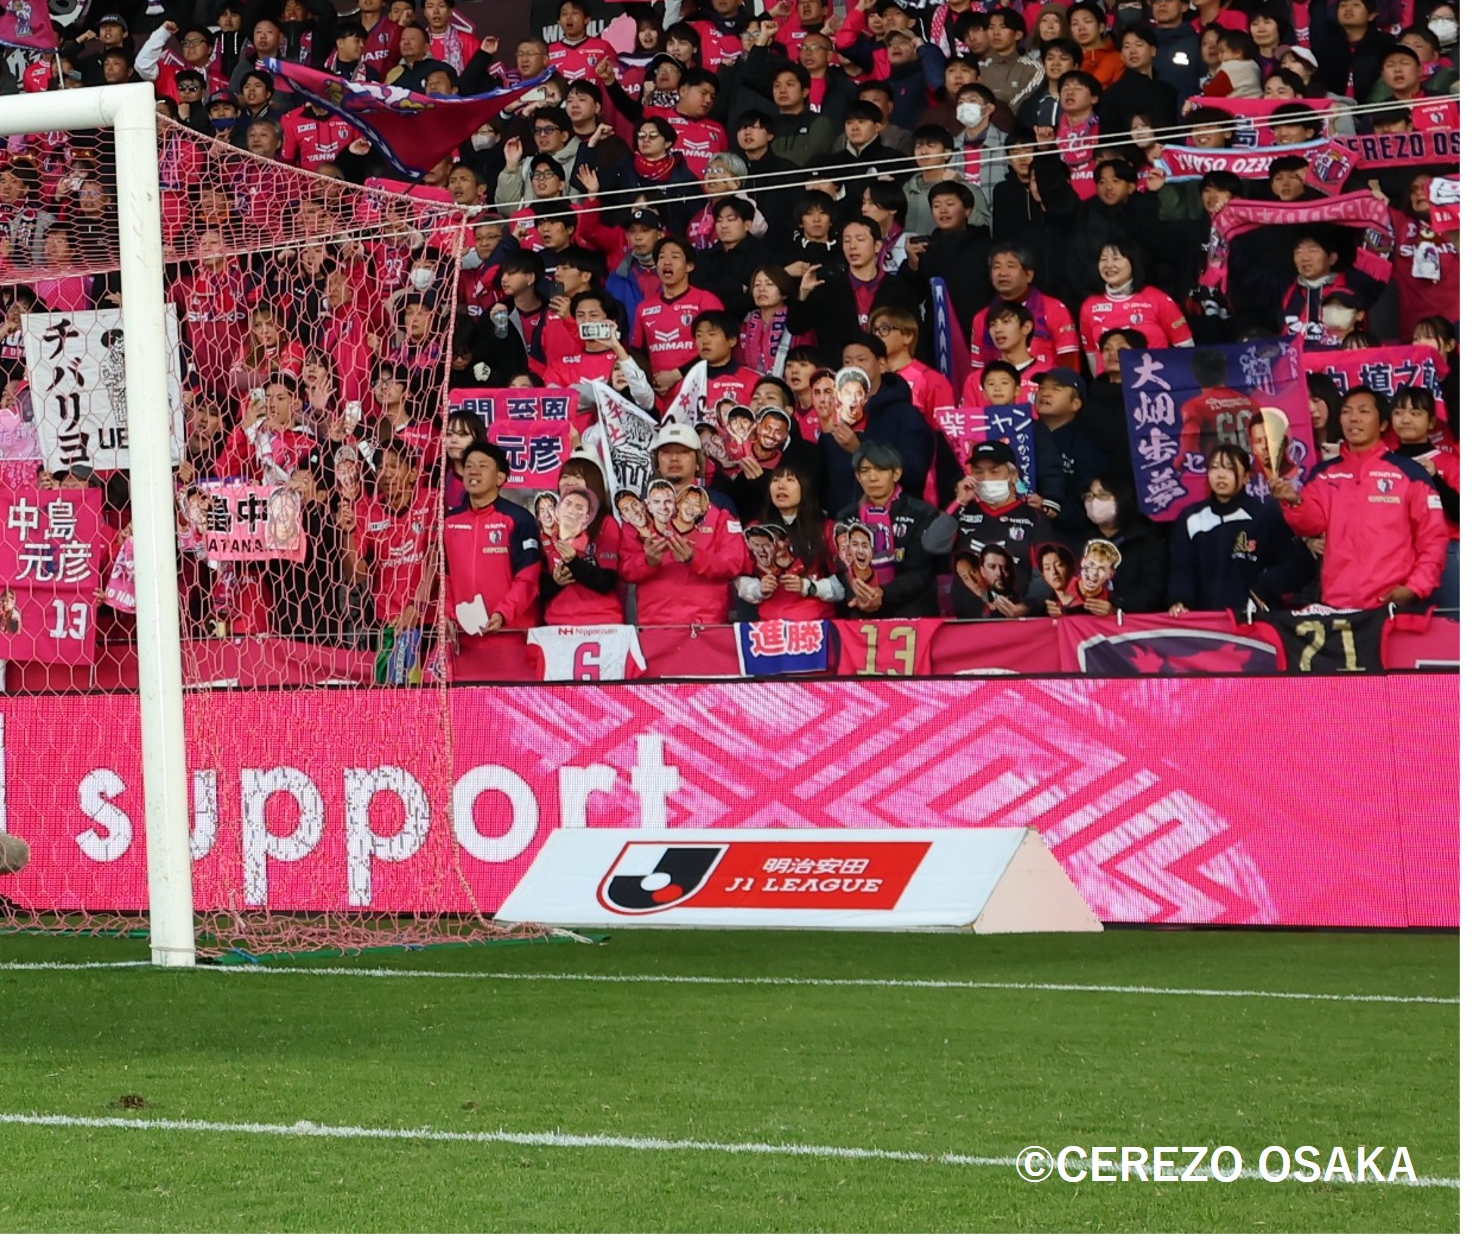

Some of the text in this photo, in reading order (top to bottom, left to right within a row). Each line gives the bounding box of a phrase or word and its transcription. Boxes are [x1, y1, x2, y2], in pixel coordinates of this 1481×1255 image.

[43, 317, 92, 467] チバリヨ
[1131, 351, 1188, 514] 大畑歩夢
[495, 434, 563, 475] 元彦
[7, 497, 79, 542] 中島
[15, 542, 93, 583] 元彦
[48, 599, 87, 640] 13
[749, 620, 822, 658] 進藤
[573, 641, 601, 682] 6
[1296, 618, 1367, 672] 21
[725, 876, 884, 895] J1 LEAGUE
[762, 856, 868, 876] 明治安田
